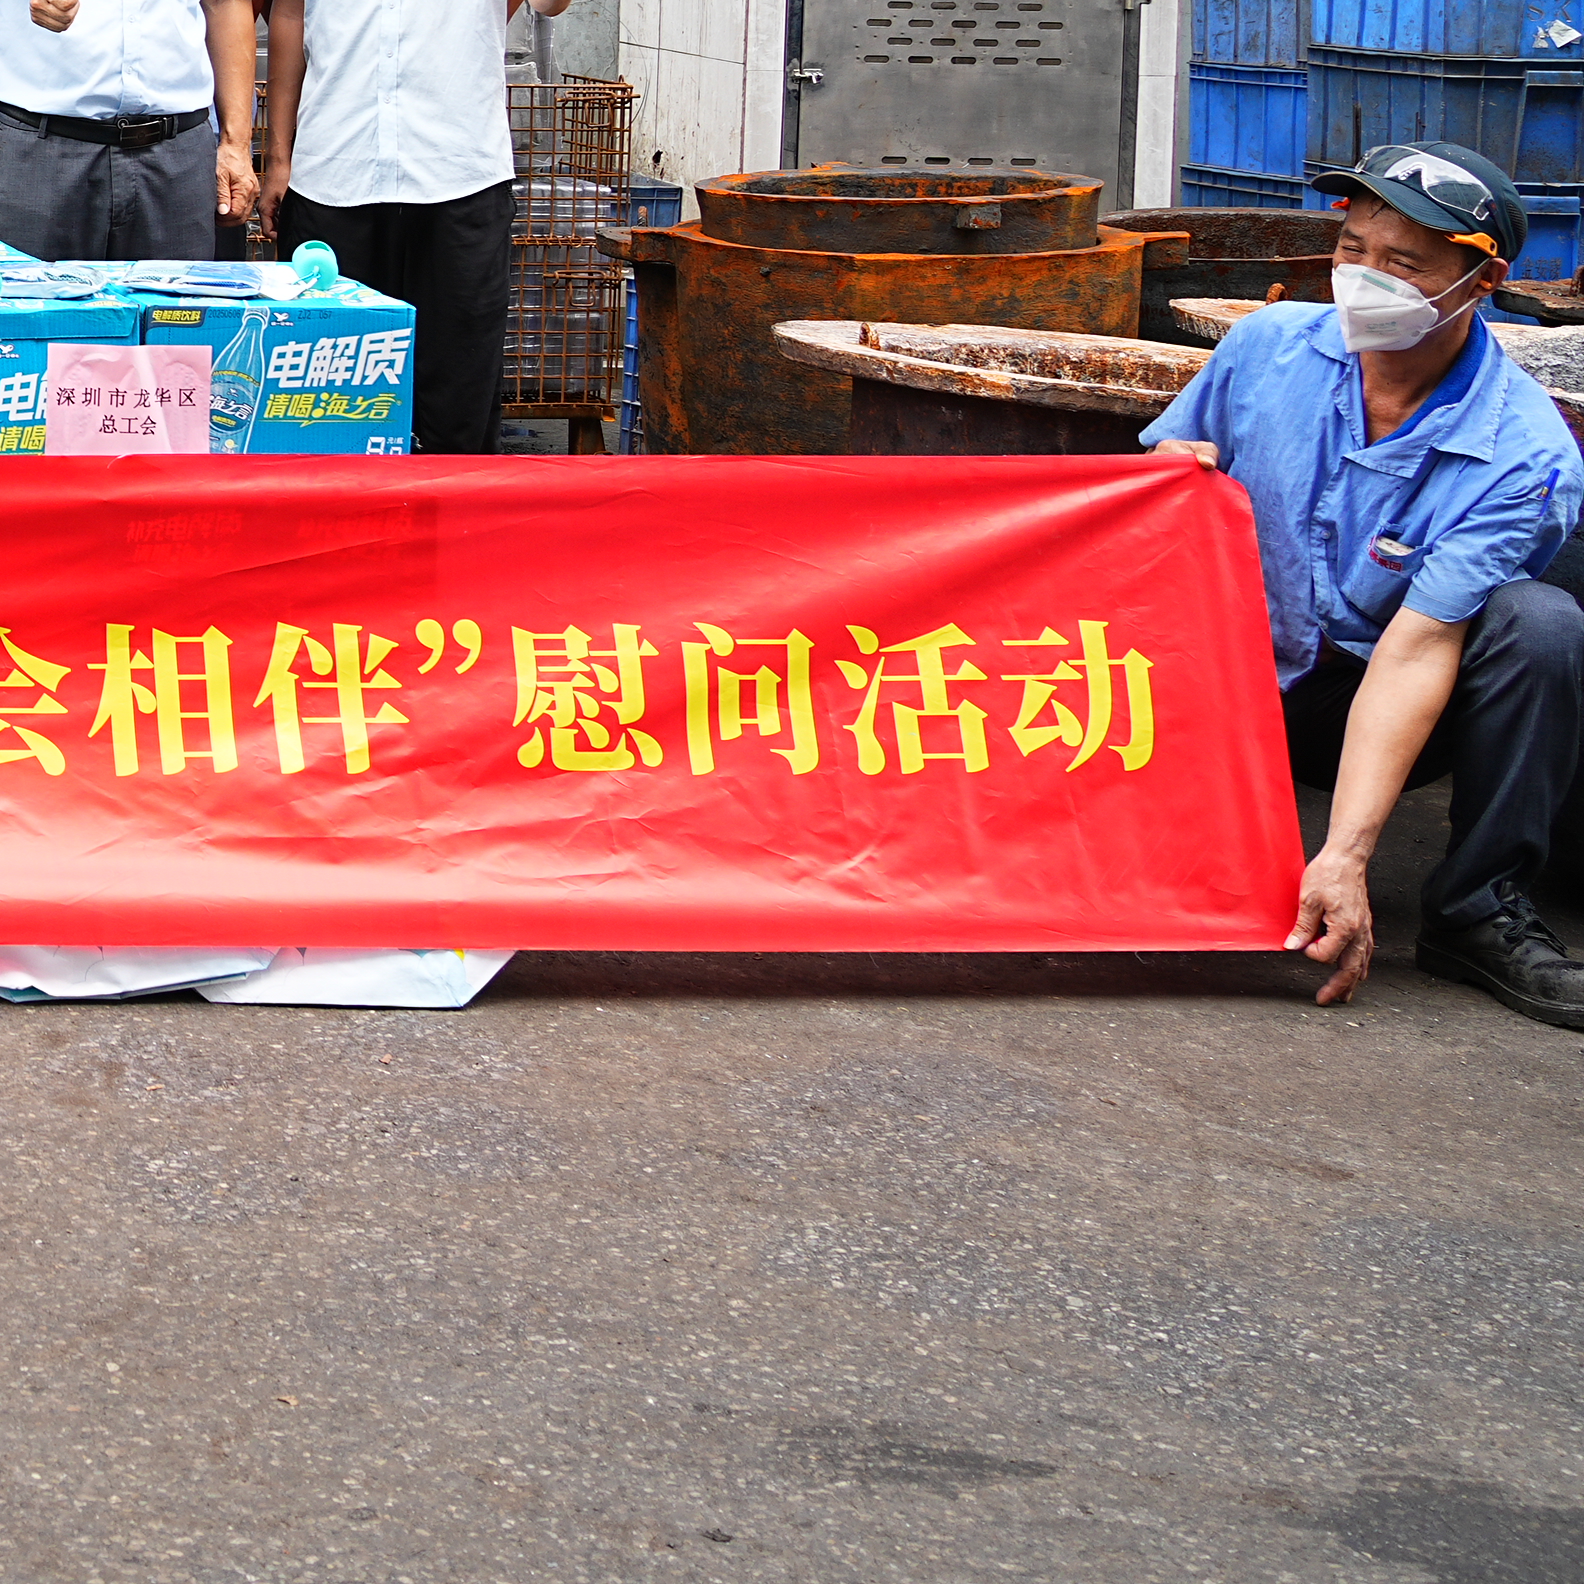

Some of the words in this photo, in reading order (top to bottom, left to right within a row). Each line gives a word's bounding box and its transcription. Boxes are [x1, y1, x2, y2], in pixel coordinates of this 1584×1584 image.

[152, 309, 202, 322] 电解质饮料
[266, 327, 413, 389] 电解质
[56, 386, 197, 409] 深圳市龙华区
[263, 391, 400, 420] 请喝海之言
[99, 415, 158, 436] 总工会
